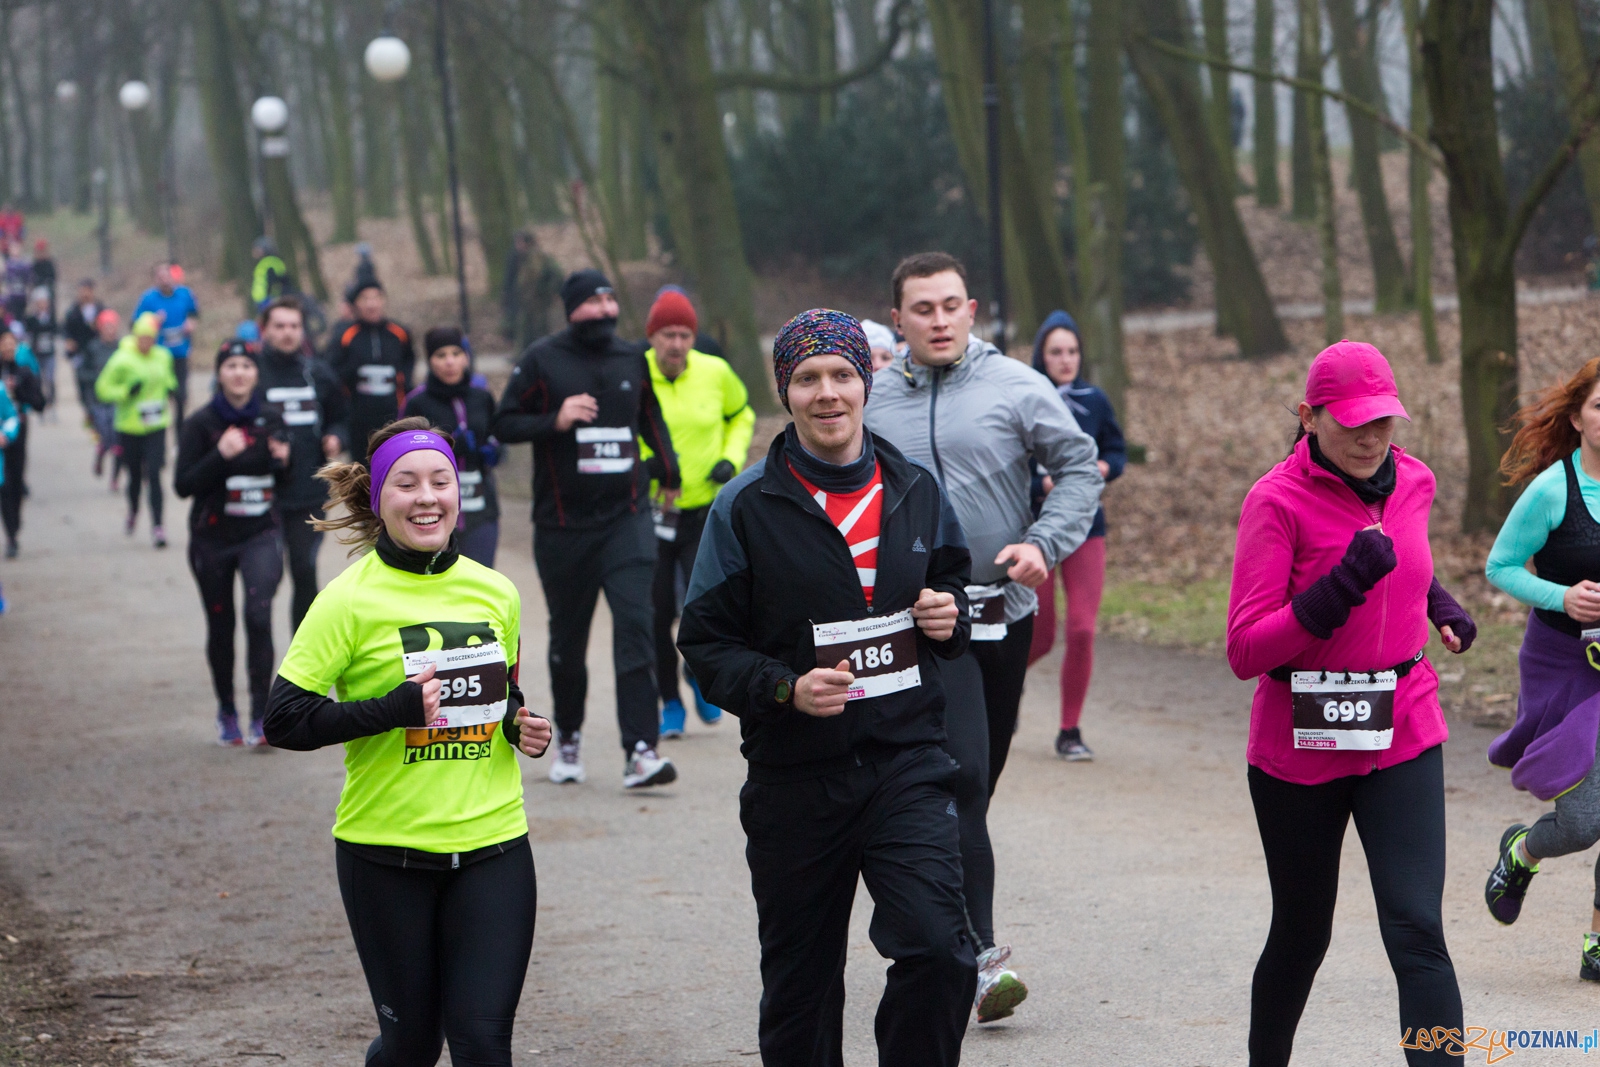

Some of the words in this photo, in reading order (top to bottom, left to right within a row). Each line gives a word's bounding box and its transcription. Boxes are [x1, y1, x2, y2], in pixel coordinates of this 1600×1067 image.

[857, 616, 910, 632] BIEGCZEKOLADOWY.PL
[446, 649, 500, 662] BIEGCZEKOLADOWY.PL
[849, 642, 894, 671] 186
[439, 674, 483, 701] 595
[1323, 700, 1372, 722] 699
[404, 742, 490, 764] runners
